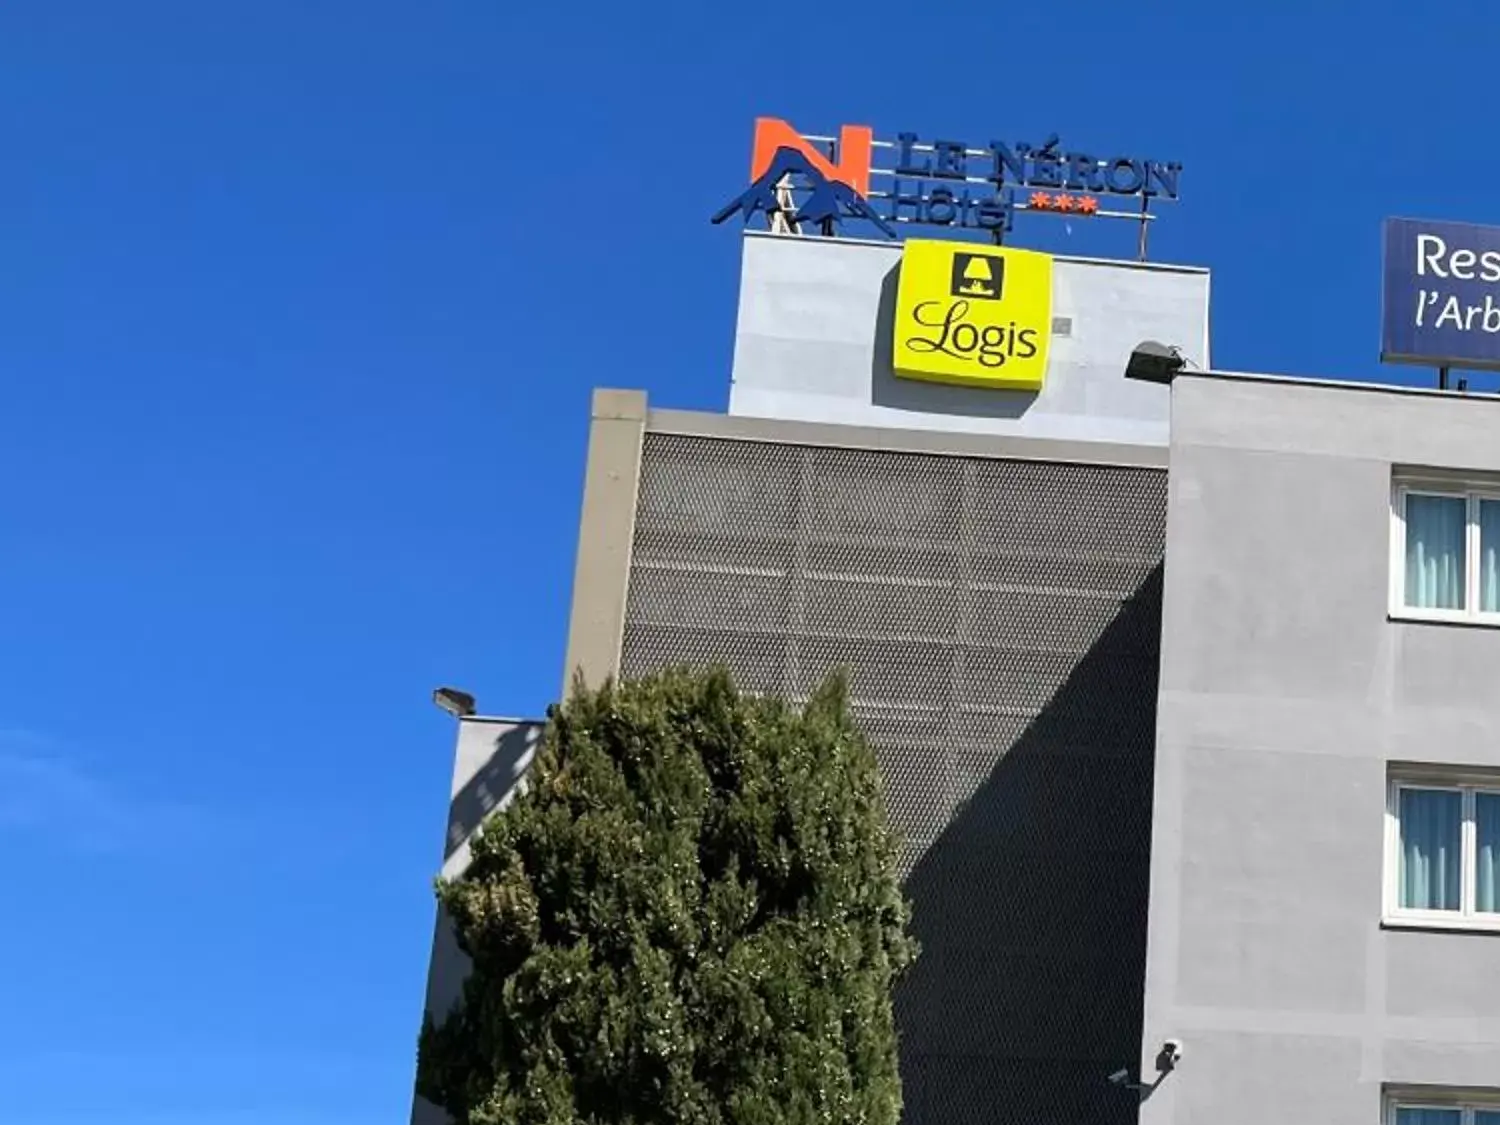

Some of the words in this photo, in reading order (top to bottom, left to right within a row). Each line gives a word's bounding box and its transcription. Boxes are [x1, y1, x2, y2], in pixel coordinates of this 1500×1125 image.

[896, 132, 967, 180] LE
[987, 133, 1183, 198] NÉRON
[892, 179, 1014, 232] Hôtel
[905, 299, 1037, 367] Logis
